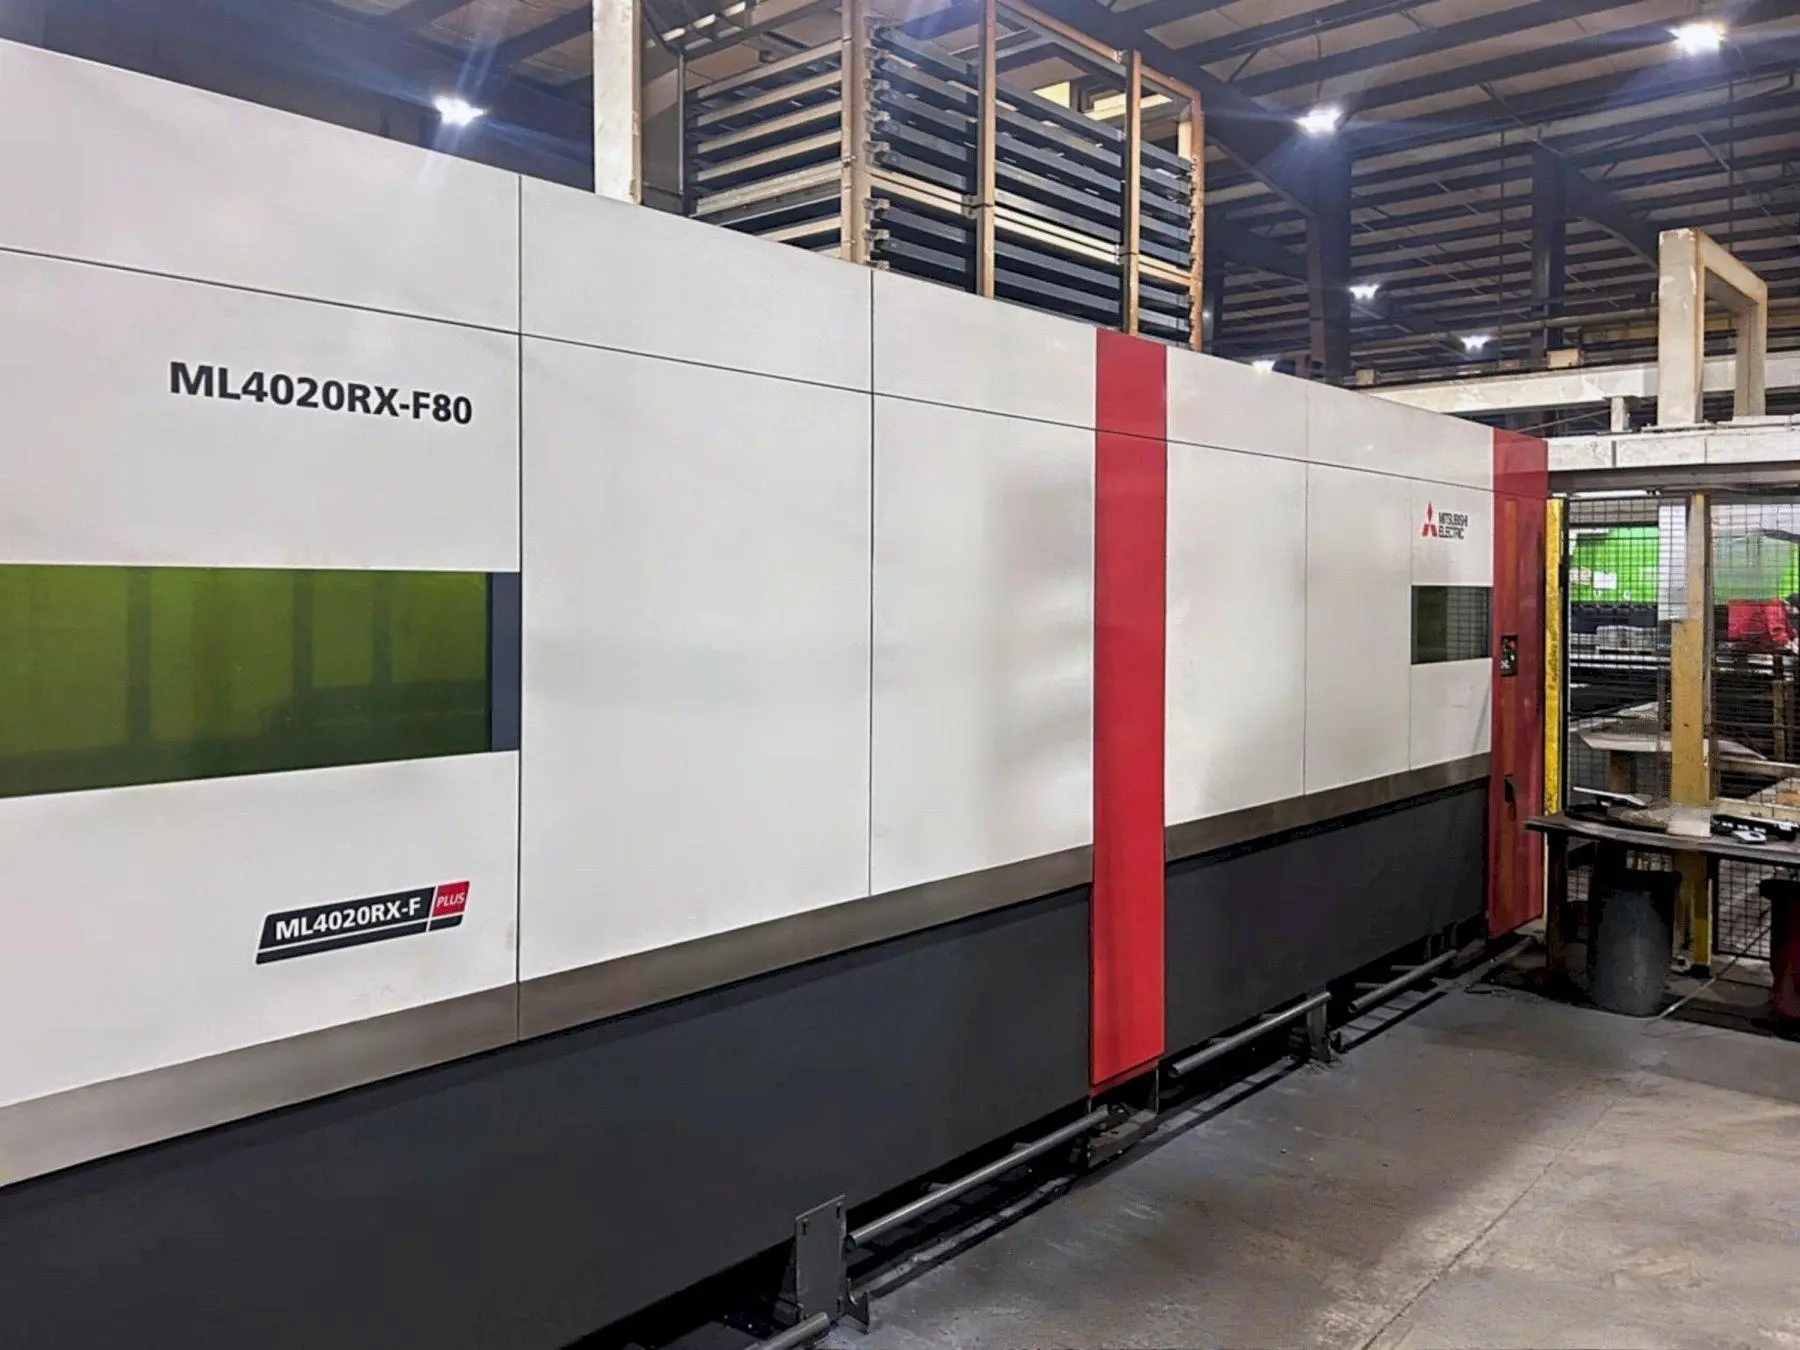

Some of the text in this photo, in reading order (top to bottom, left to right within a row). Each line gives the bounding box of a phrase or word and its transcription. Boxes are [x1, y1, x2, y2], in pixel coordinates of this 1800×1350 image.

[170, 361, 472, 425] ML4020RX-F80
[275, 891, 466, 940] ML4020RX-F PLUS
